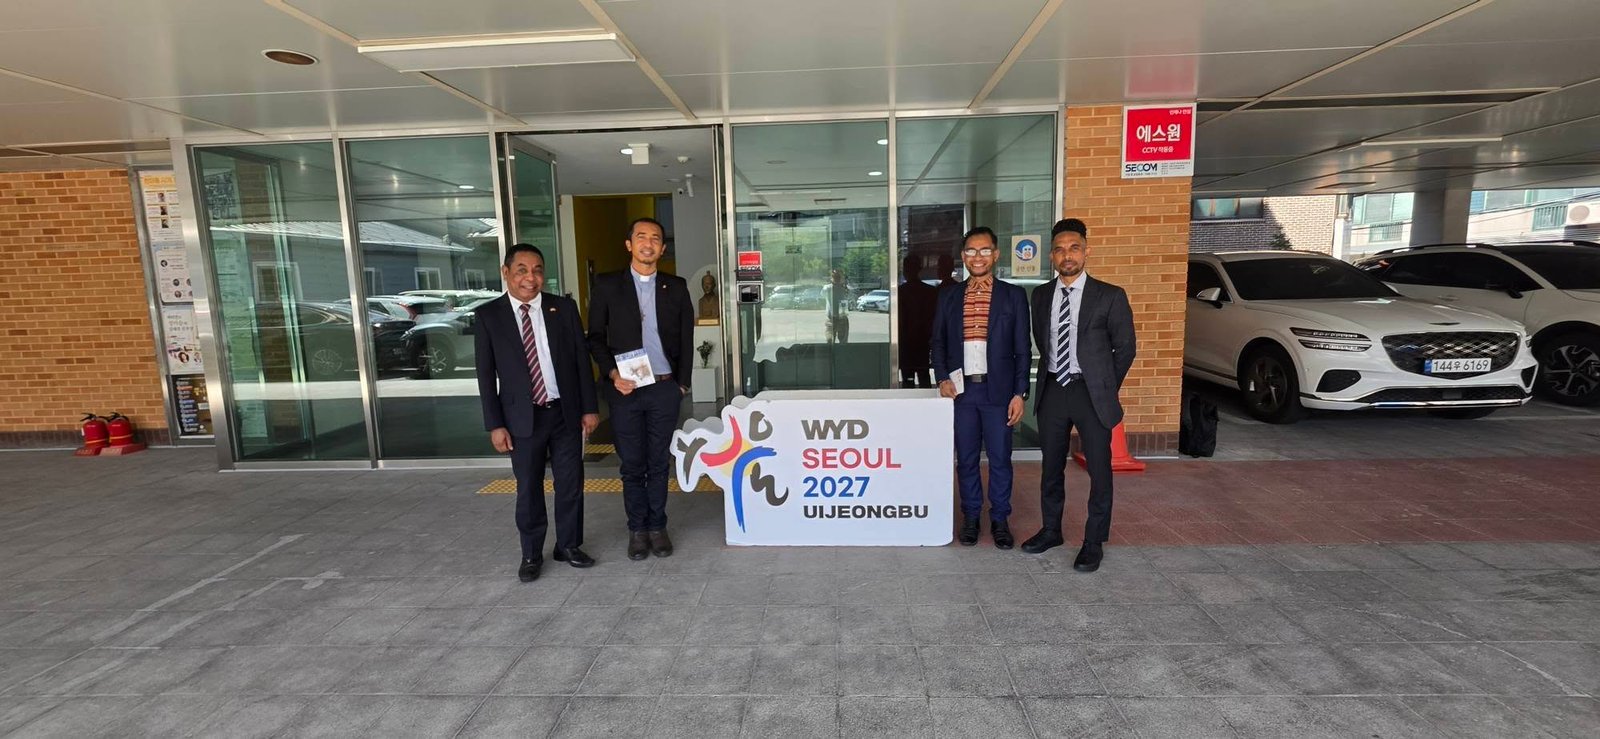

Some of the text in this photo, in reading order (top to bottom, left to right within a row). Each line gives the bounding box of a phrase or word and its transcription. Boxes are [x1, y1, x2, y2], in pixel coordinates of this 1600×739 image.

[1136, 123, 1181, 143] 에스원
[1125, 163, 1158, 172] SECOM
[1434, 360, 1489, 371] 144우 6169
[801, 419, 869, 440] WYD
[802, 448, 901, 469] SEOUL
[803, 476, 870, 498] 2027
[803, 505, 929, 519] UIJEONGBU
